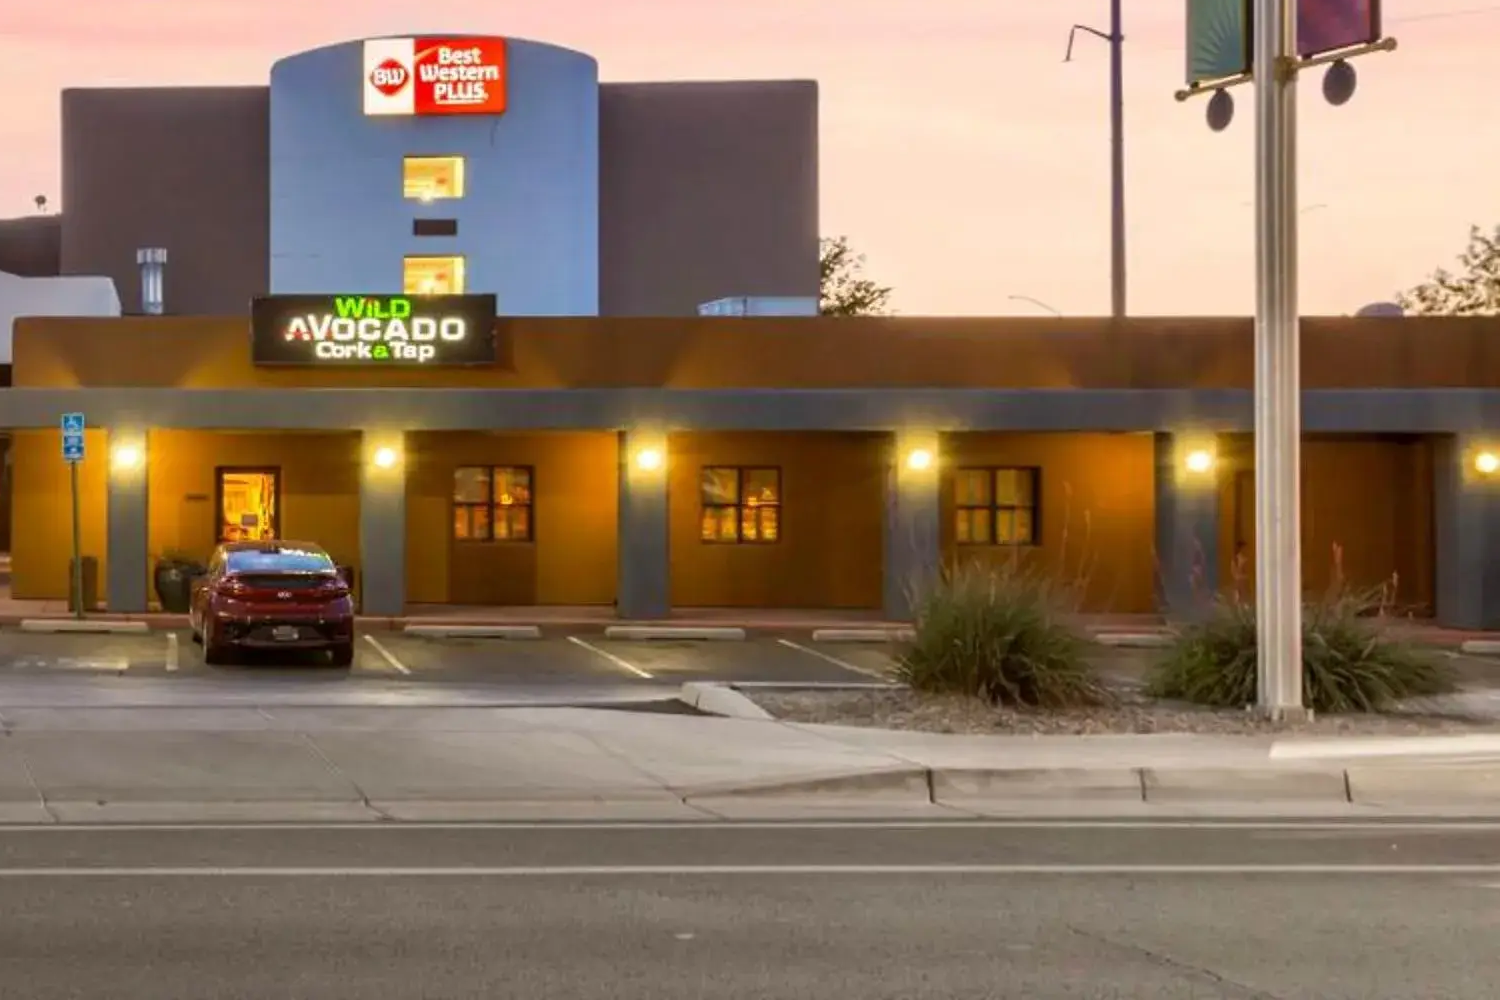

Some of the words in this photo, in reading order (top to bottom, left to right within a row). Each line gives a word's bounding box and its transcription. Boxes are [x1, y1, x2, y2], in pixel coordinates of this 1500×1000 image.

[438, 47, 481, 64] Best
[373, 69, 403, 85] BW
[420, 65, 498, 82] Western
[434, 83, 486, 99] PLUS
[284, 313, 466, 342] AVOCADO
